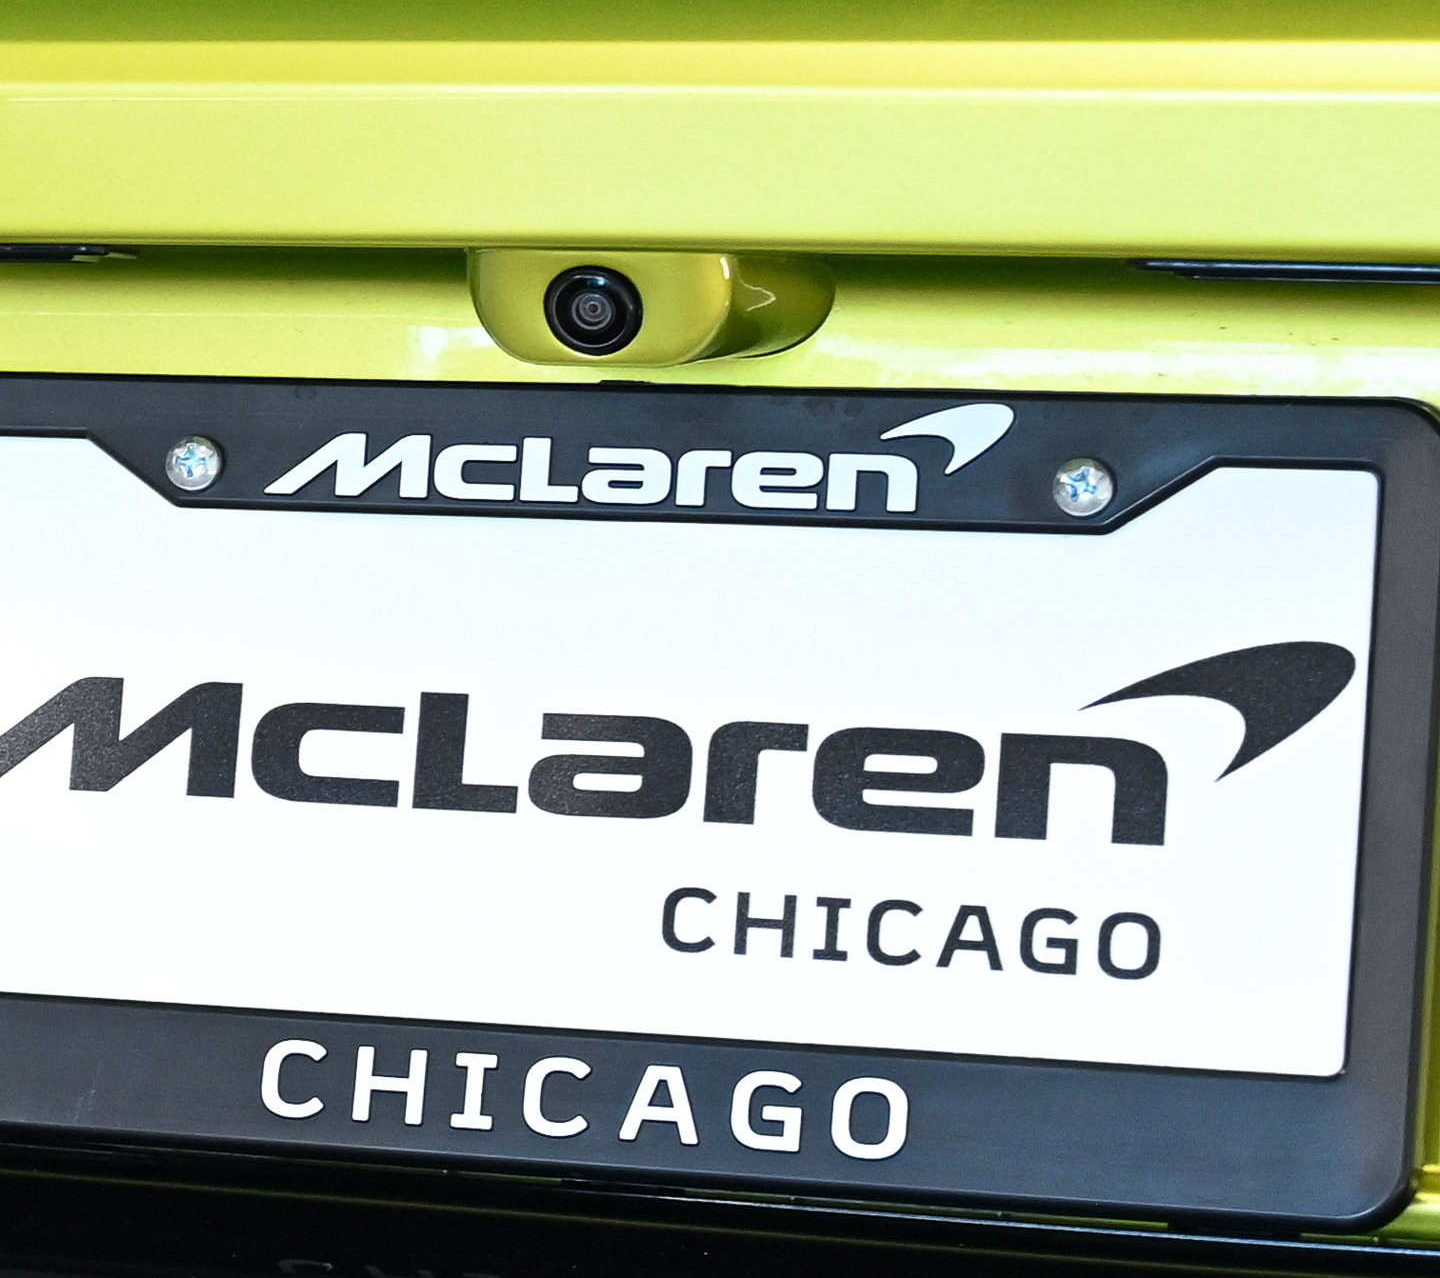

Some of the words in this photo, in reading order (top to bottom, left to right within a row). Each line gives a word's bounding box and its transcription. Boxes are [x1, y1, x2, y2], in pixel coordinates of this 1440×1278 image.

[264, 433, 918, 512] McLaren
[661, 886, 1162, 981] CHICAGO
[260, 1038, 911, 1161] CHICAGO
